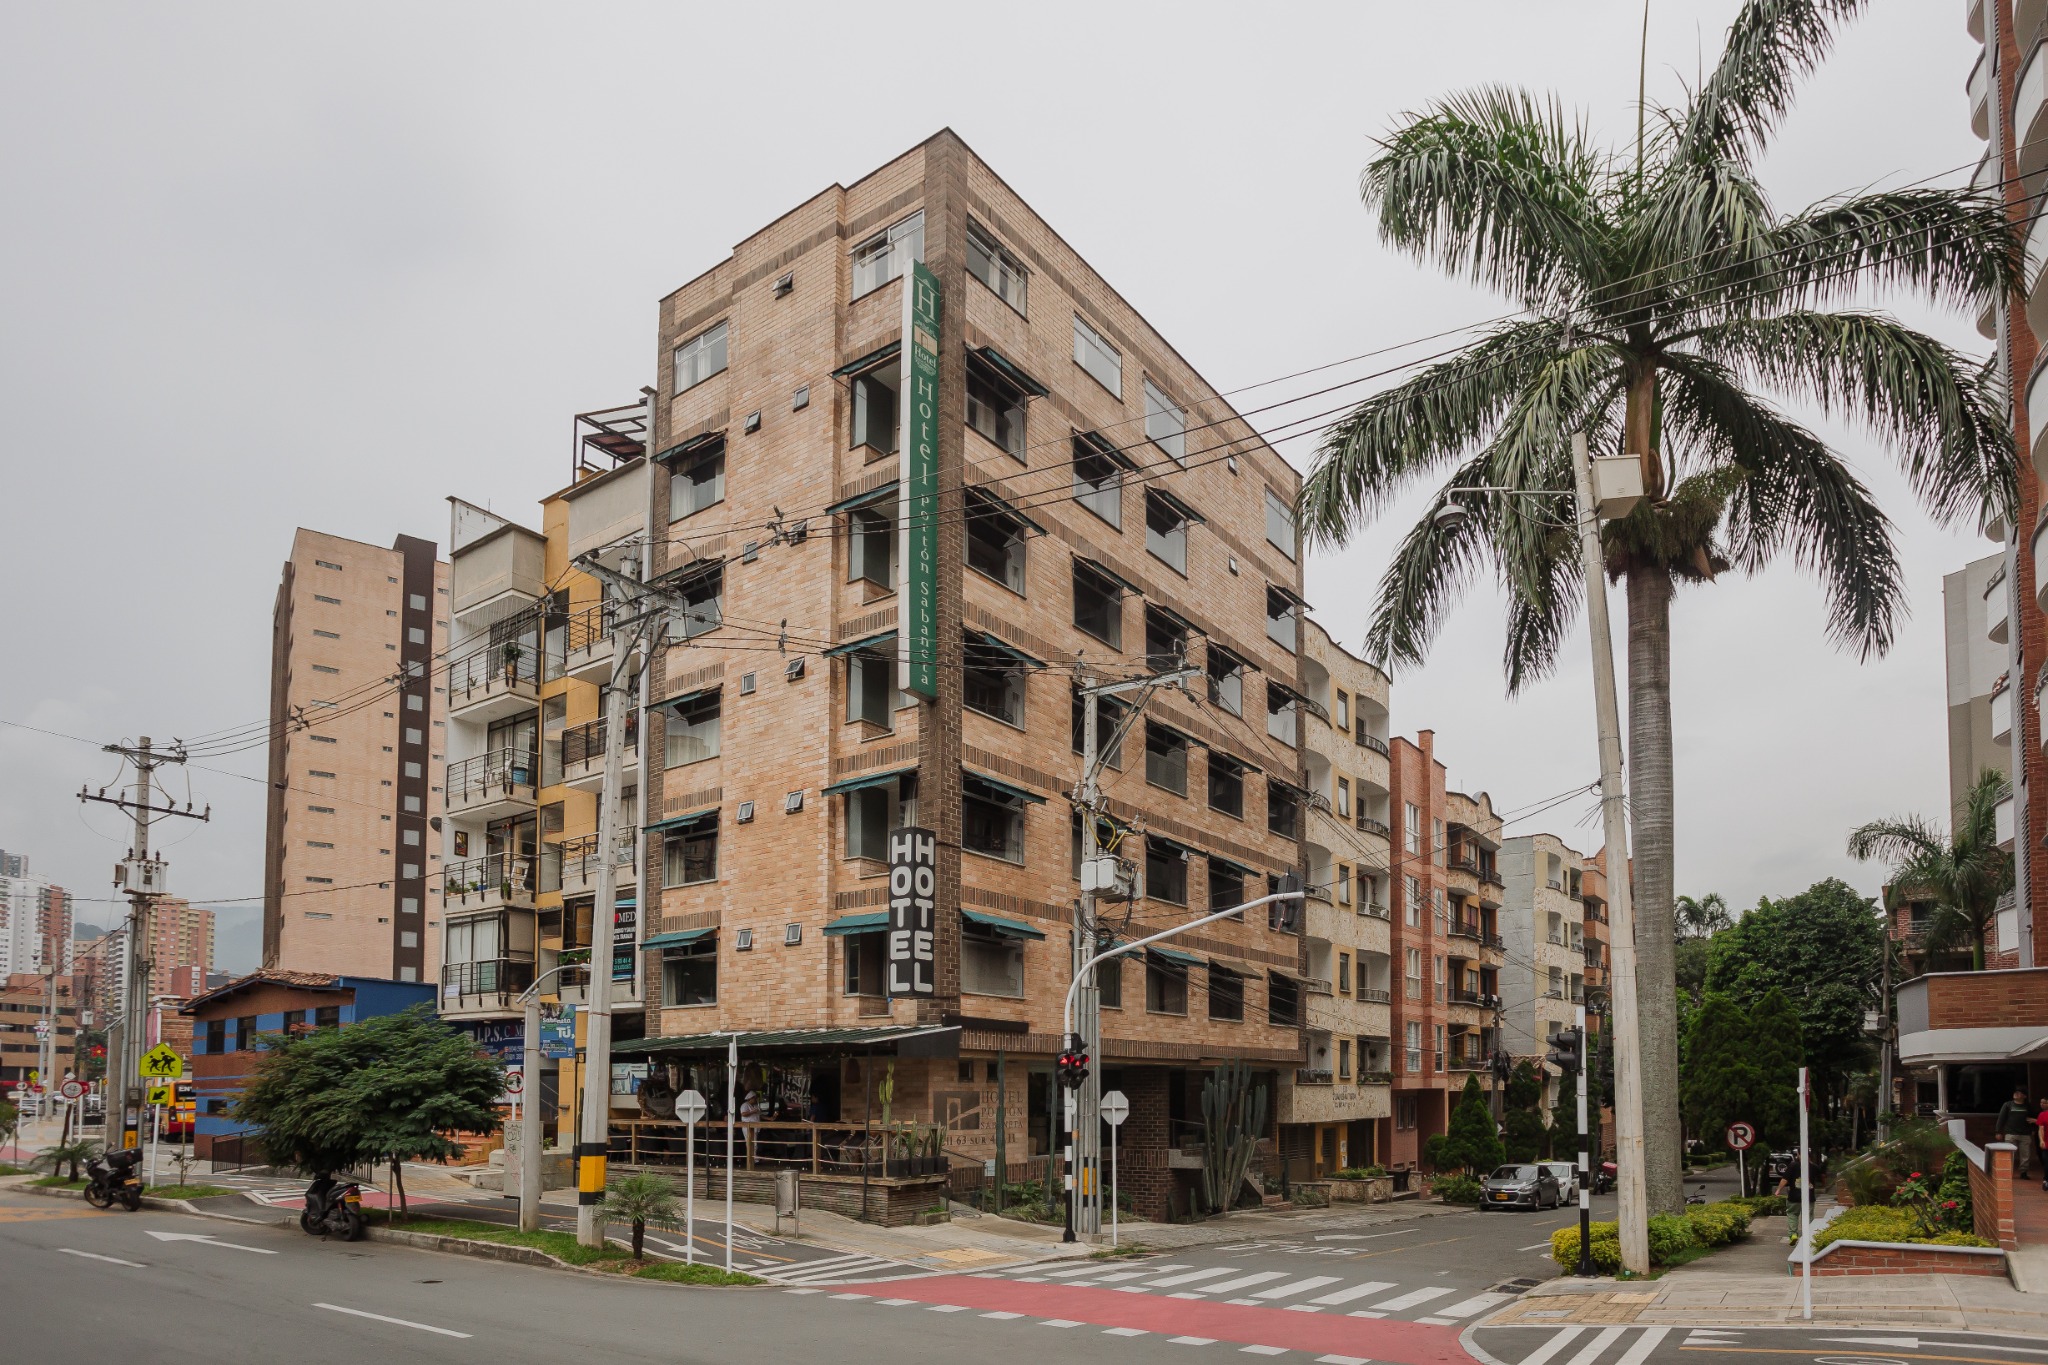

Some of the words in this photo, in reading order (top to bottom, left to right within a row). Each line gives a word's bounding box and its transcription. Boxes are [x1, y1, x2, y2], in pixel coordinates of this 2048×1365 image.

[917, 281, 935, 320] H
[914, 345, 936, 368] Hotel
[918, 376, 933, 485] Hotel
[890, 834, 912, 993] HOTEL
[914, 834, 935, 993] HOTEL
[956, 1135, 966, 1145] 63
[969, 1136, 986, 1145] SUR
[1733, 1127, 1748, 1145] P
